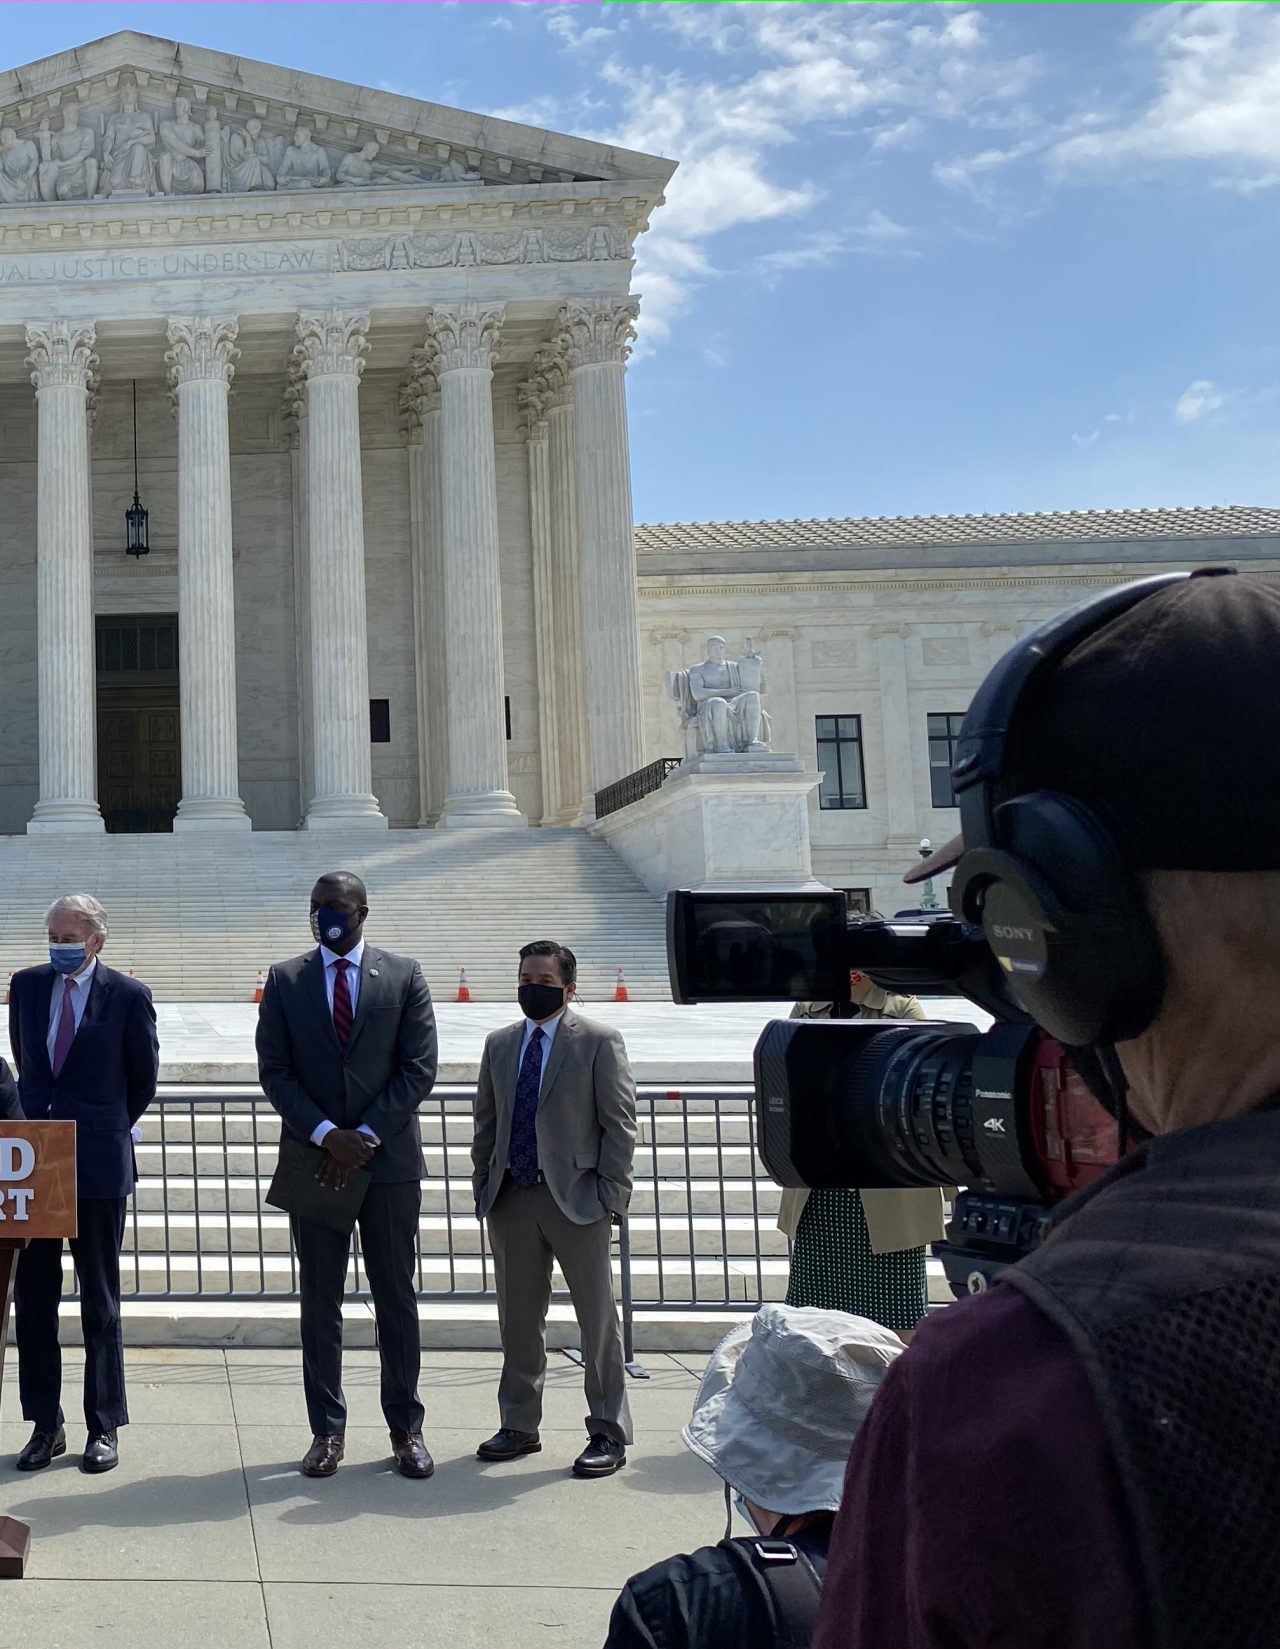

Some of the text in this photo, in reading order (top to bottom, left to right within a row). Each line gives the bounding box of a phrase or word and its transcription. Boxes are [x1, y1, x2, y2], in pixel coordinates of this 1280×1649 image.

[44, 256, 149, 281] JUSTICE
[163, 252, 250, 274] UNDER
[263, 249, 315, 270] LAW
[992, 924, 1033, 940] SONY
[983, 1118, 1006, 1132] 4K
